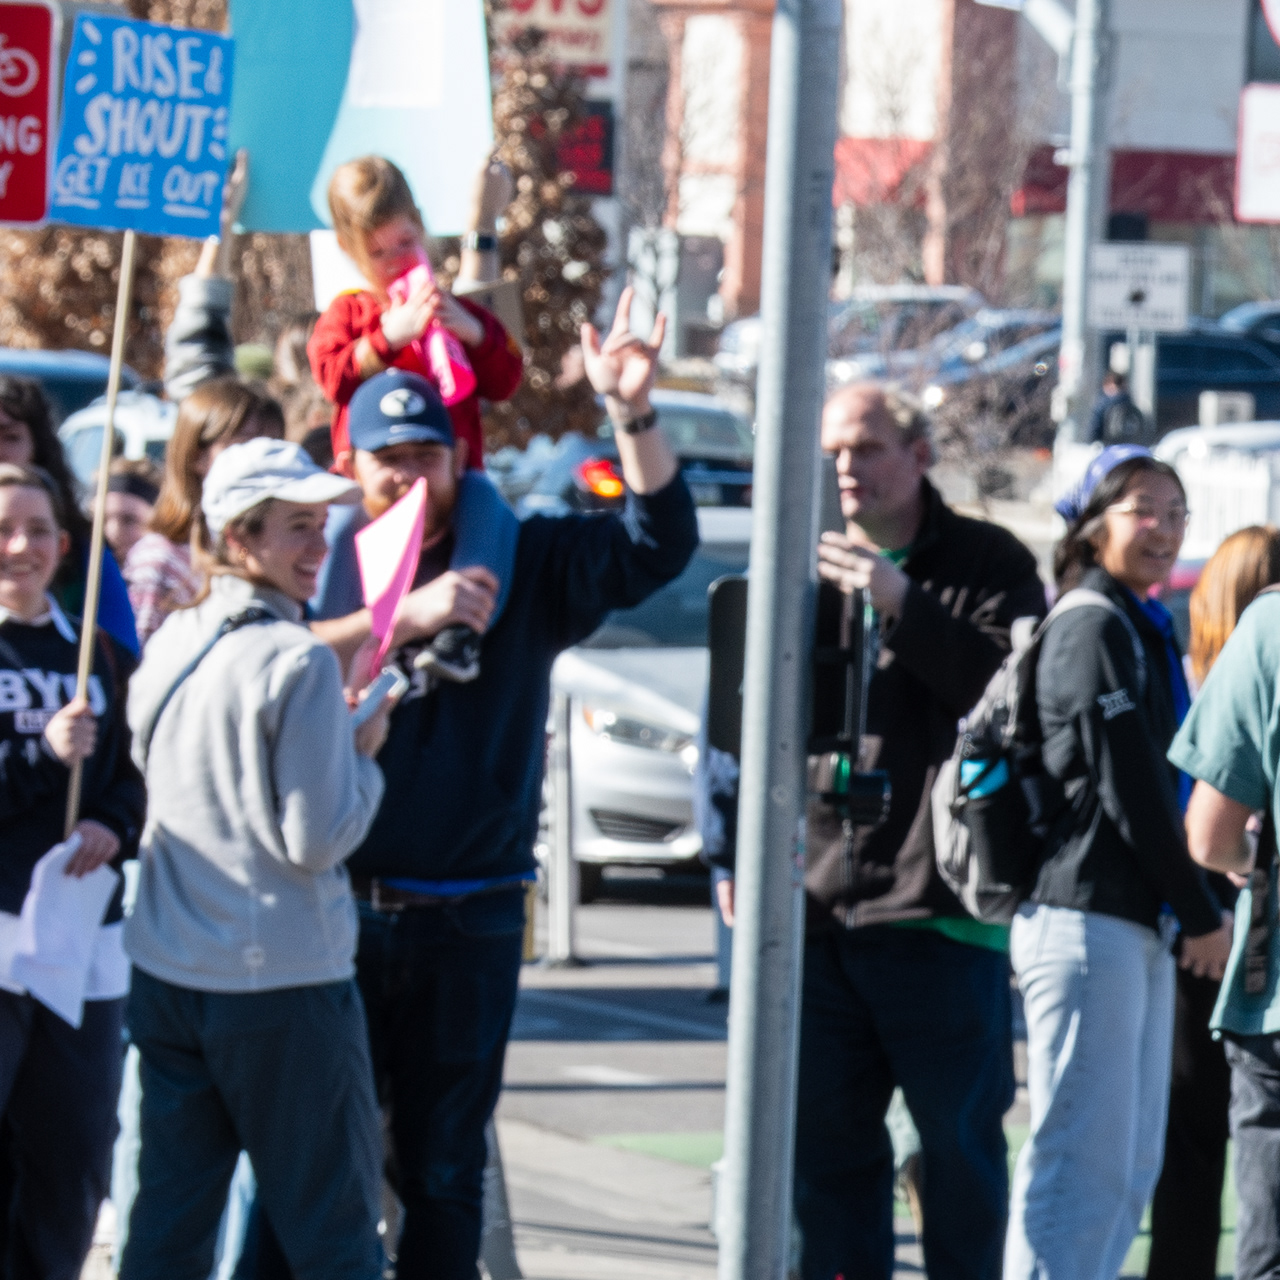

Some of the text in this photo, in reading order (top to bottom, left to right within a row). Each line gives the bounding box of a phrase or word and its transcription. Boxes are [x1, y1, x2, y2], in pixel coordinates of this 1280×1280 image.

[112, 26, 205, 98] RISE
[74, 92, 213, 162] SHOUT
[54, 154, 111, 196] GET
[162, 165, 220, 205] OUT
